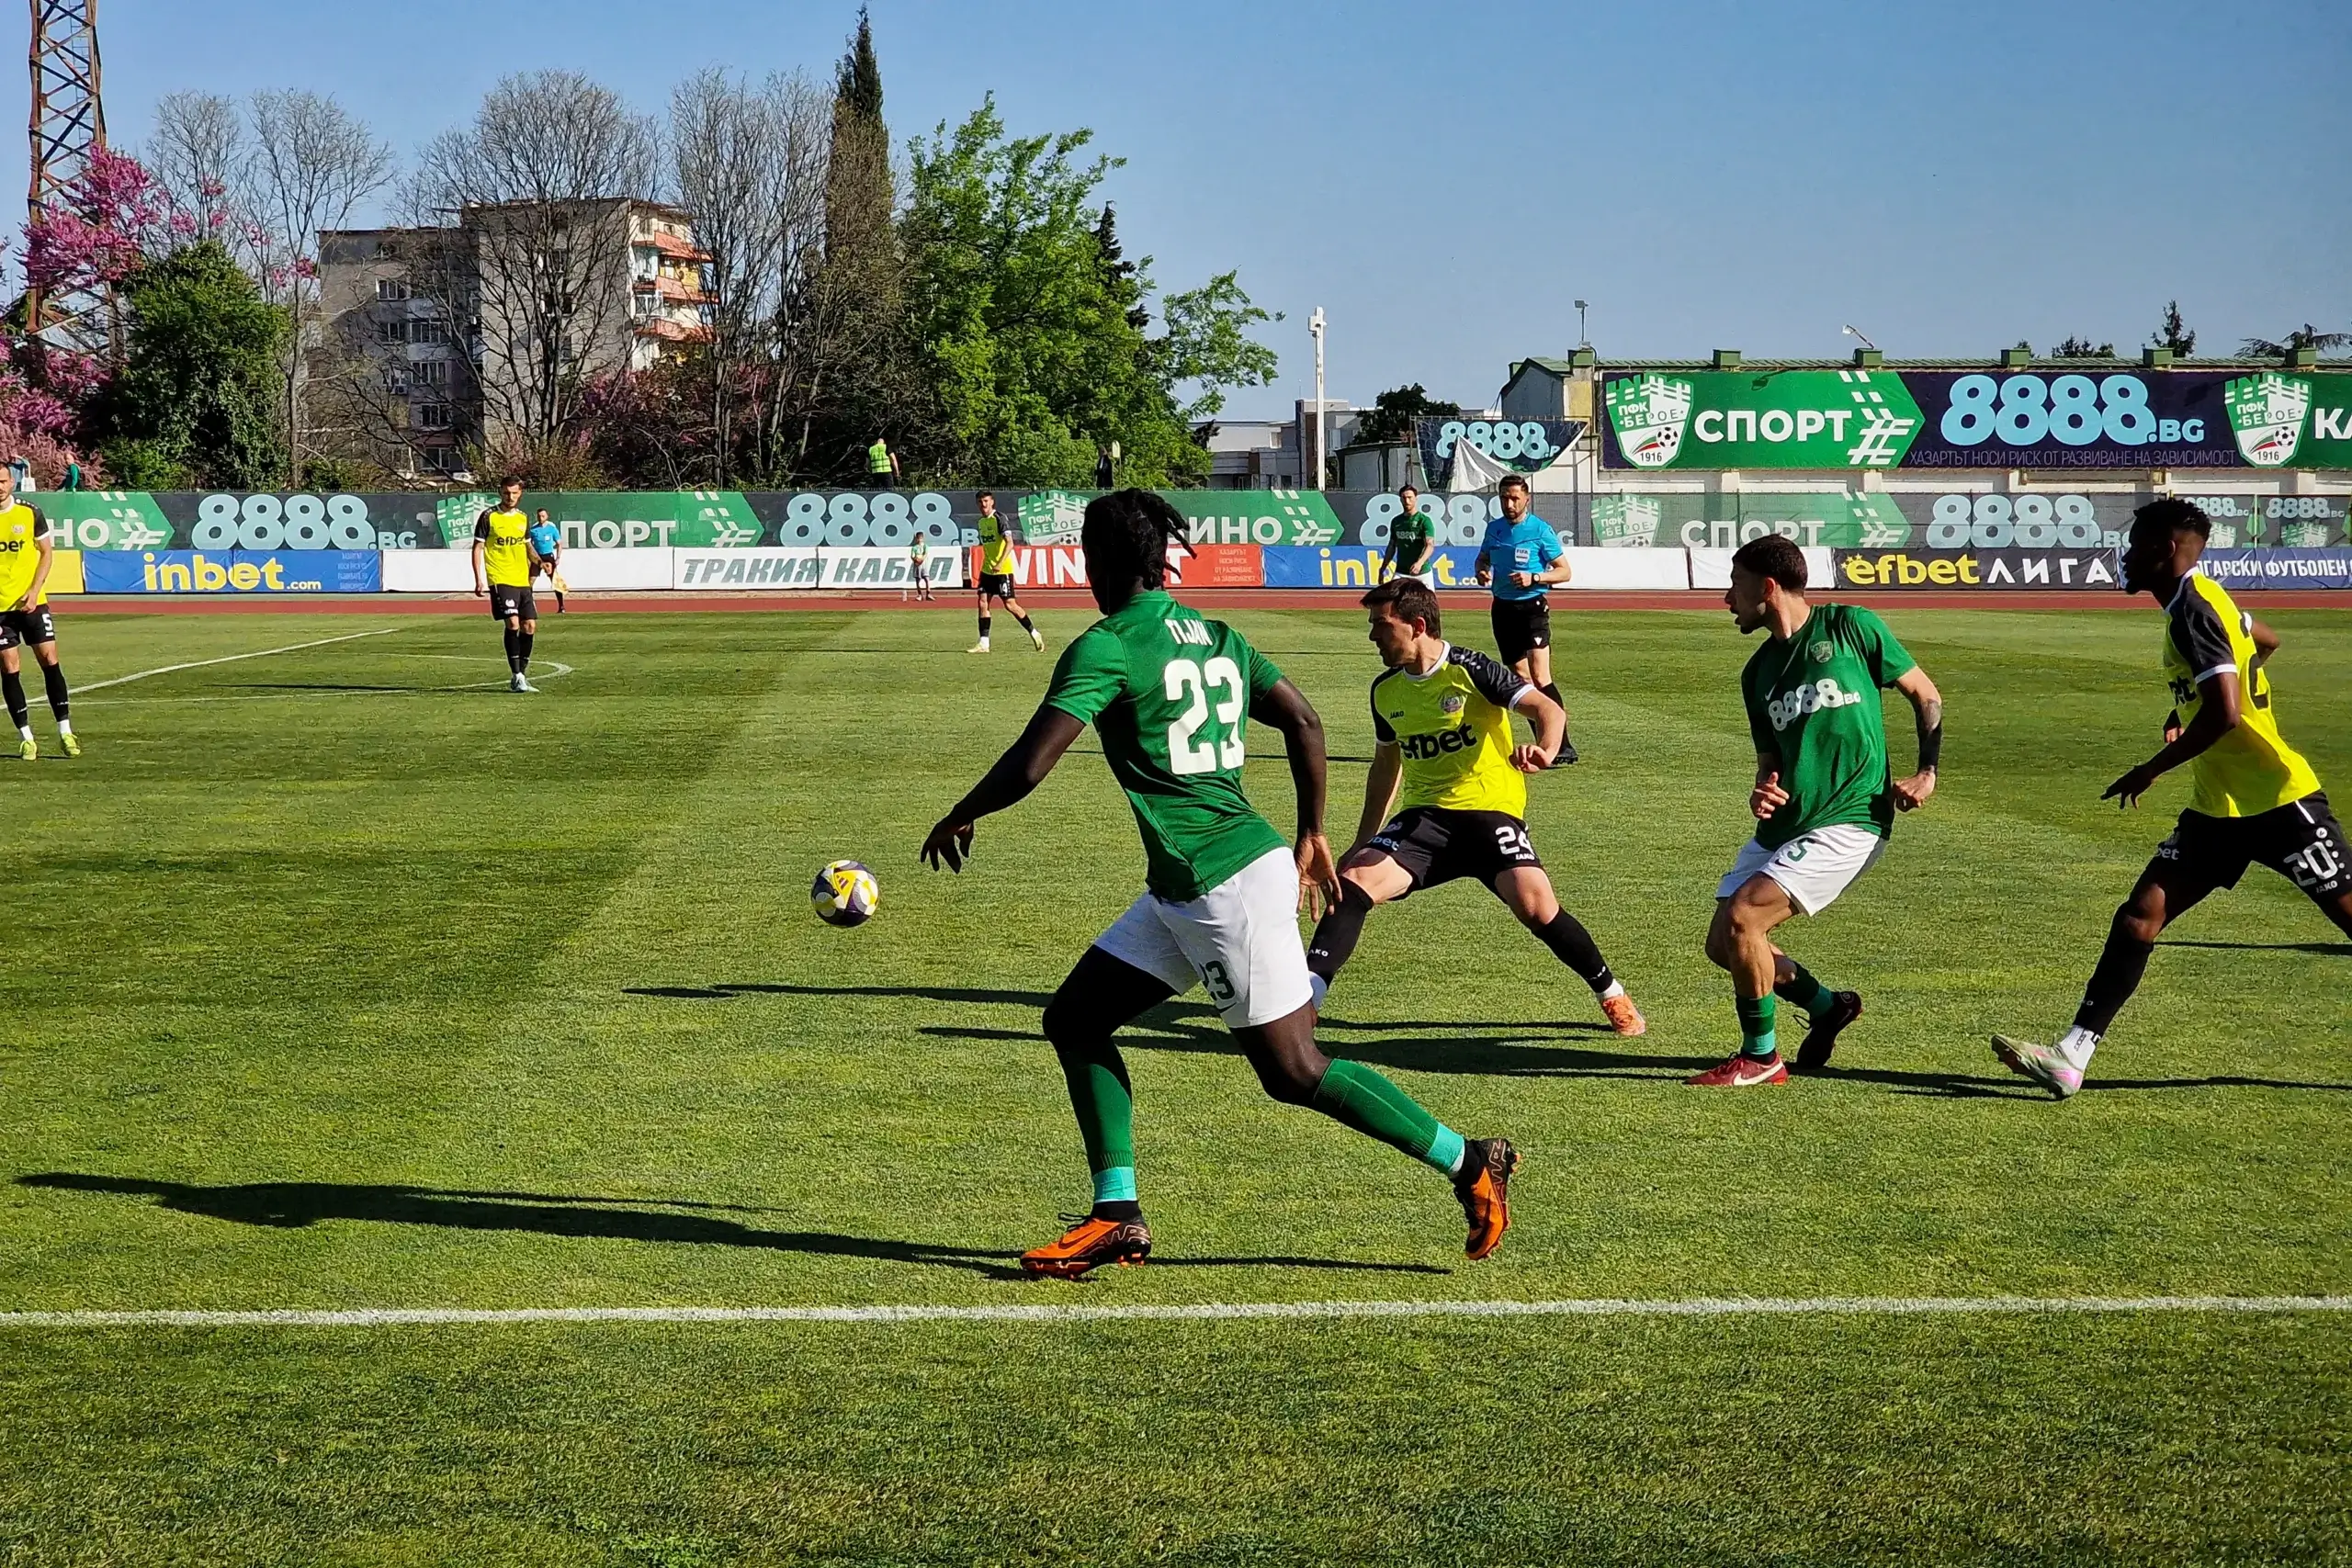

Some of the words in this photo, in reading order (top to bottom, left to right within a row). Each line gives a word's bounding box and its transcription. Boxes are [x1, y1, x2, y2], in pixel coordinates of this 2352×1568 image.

[1618, 401, 1648, 416] ПФК
[1940, 375, 2204, 446] 8888.BG
[2236, 400, 2267, 415] ПФК
[1694, 410, 1852, 443] СПОРТ
[1641, 452, 1662, 462] 1916
[1909, 450, 1969, 466] ХАЗАРТЪТ
[1972, 450, 2006, 466] НОСИ
[2008, 450, 2041, 466] РИСК
[2043, 450, 2059, 465] ОТ
[2062, 450, 2132, 465] РАЗВИВАНЕ
[2134, 450, 2151, 465] НА
[2154, 450, 2236, 465] ЗАВИСИМОСТ
[2257, 451, 2279, 461] 1916
[191, 493, 416, 550] 8888.BG
[447, 515, 471, 527] ПФК
[780, 492, 980, 547] 8888.B
[1028, 513, 1053, 525] ПФК
[1601, 516, 1624, 527] ПФК
[560, 520, 676, 547] ПОРТ
[143, 553, 322, 592] inbet.com
[683, 558, 830, 584] ТРАКИЯ
[1846, 554, 1980, 584] efbet
[1987, 558, 2113, 584] ЛИГА
[2266, 559, 2347, 577] ФУТБОЛЕН
[42, 613, 53, 631] 5
[1164, 657, 1244, 774] 23
[2283, 841, 2338, 886] 20
[1308, 948, 1329, 957] AKO
